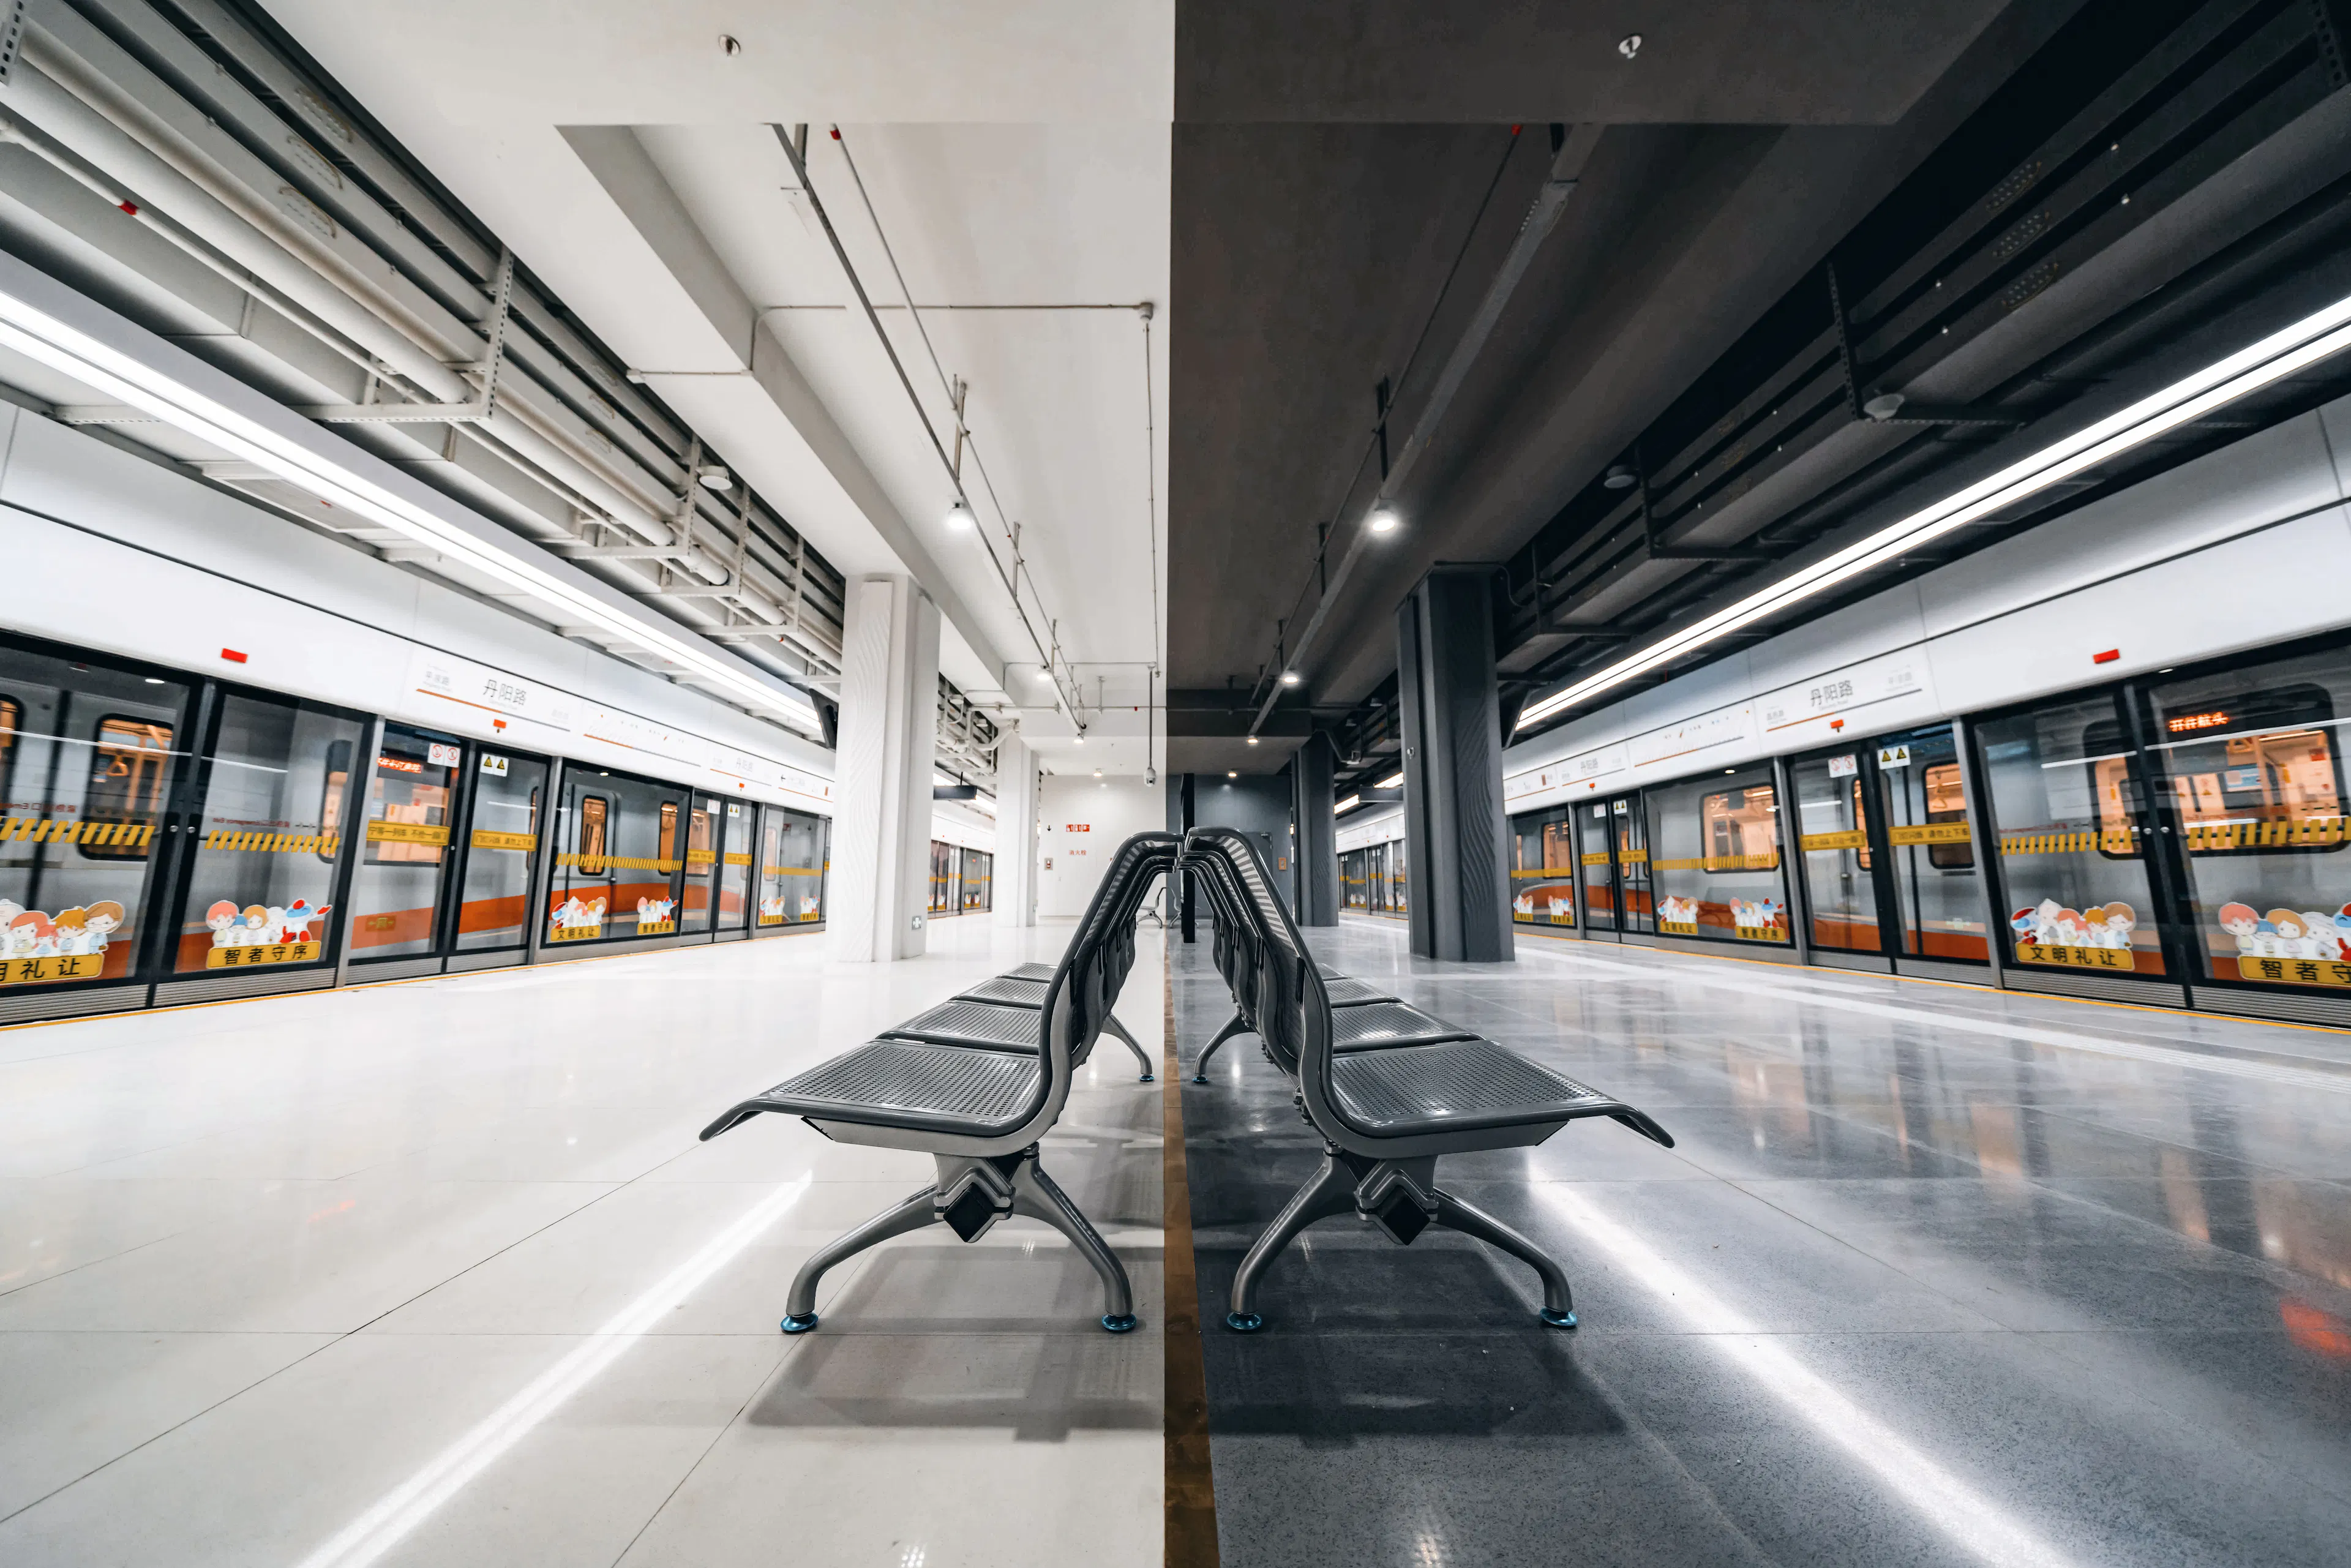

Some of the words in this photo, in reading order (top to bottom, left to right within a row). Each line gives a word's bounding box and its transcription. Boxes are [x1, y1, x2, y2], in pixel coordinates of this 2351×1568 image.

[483, 679, 527, 705] 丹阳路
[1810, 680, 1853, 707] 丹阳路
[2169, 711, 2229, 732] 开往航头
[224, 945, 309, 966] 智者守序
[2030, 946, 2118, 966] 文明礼让
